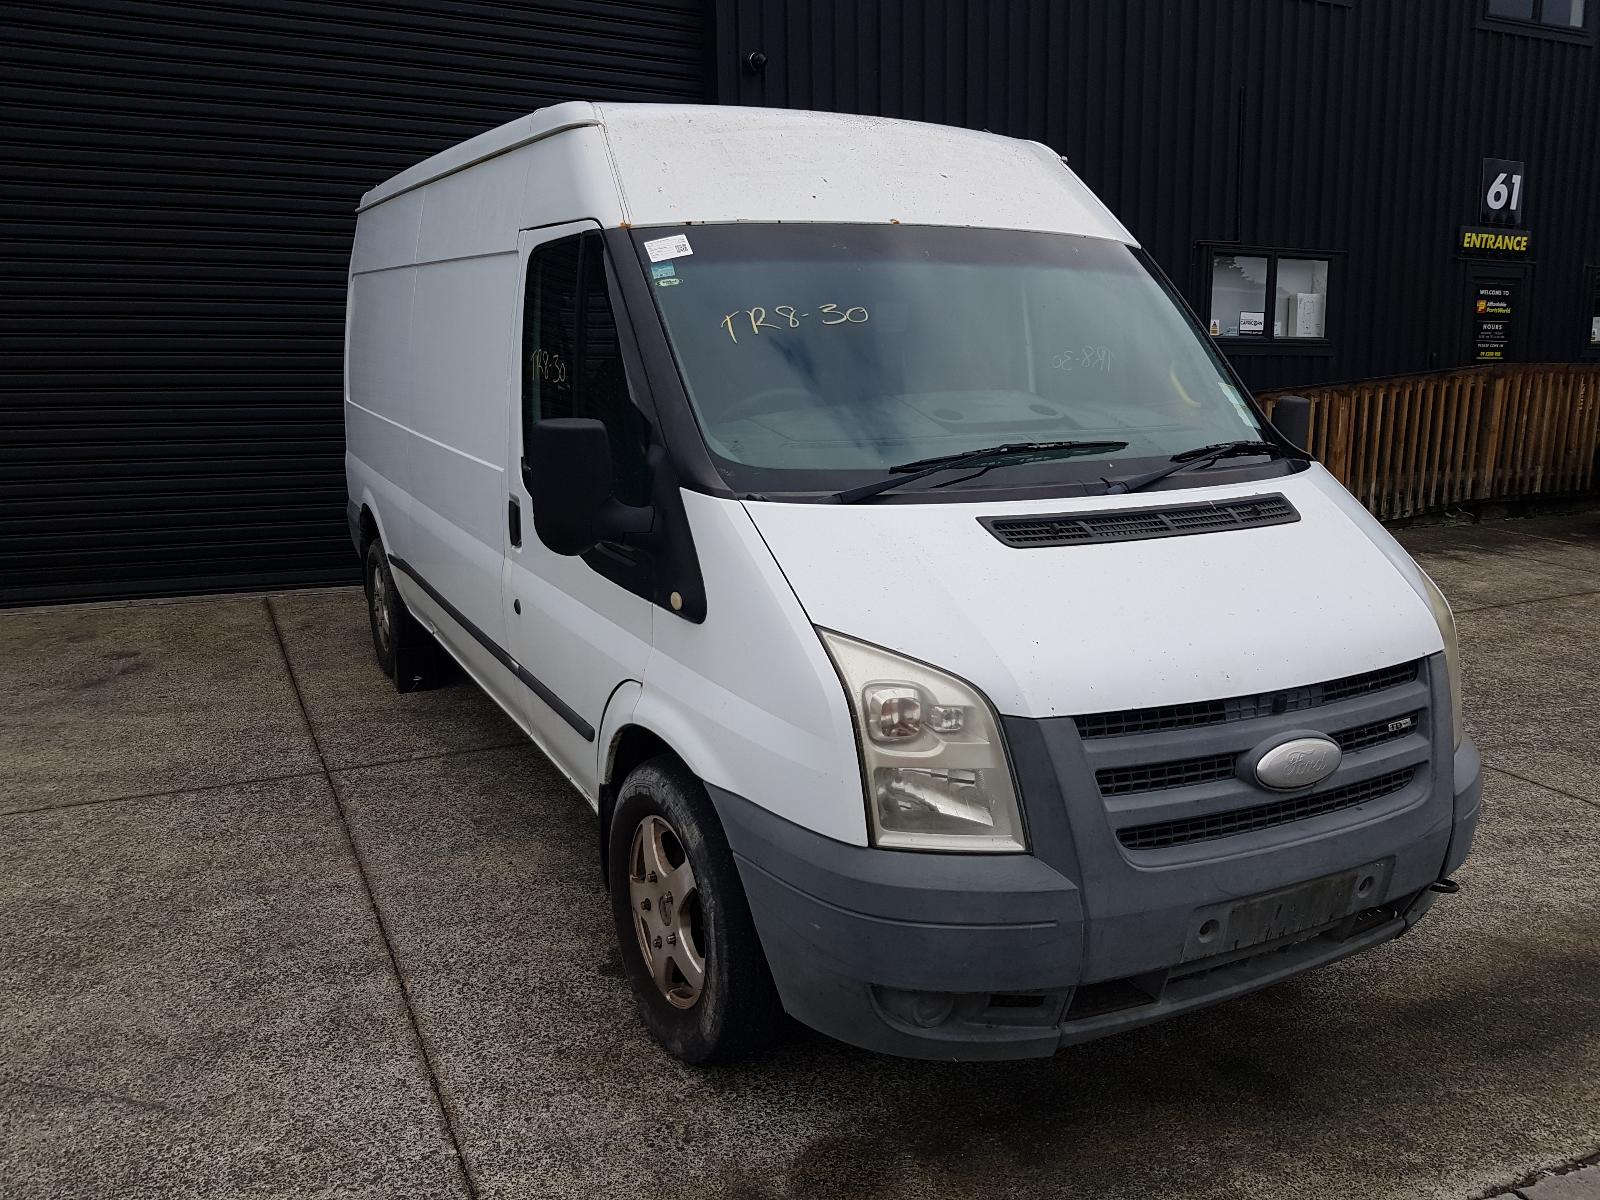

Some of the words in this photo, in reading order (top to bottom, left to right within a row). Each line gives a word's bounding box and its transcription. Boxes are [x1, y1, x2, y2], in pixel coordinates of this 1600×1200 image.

[1487, 173, 1521, 210] 61
[1463, 233, 1528, 251] ENTRANCE
[721, 304, 868, 344] TR8-30
[1286, 750, 1327, 775] Ford
